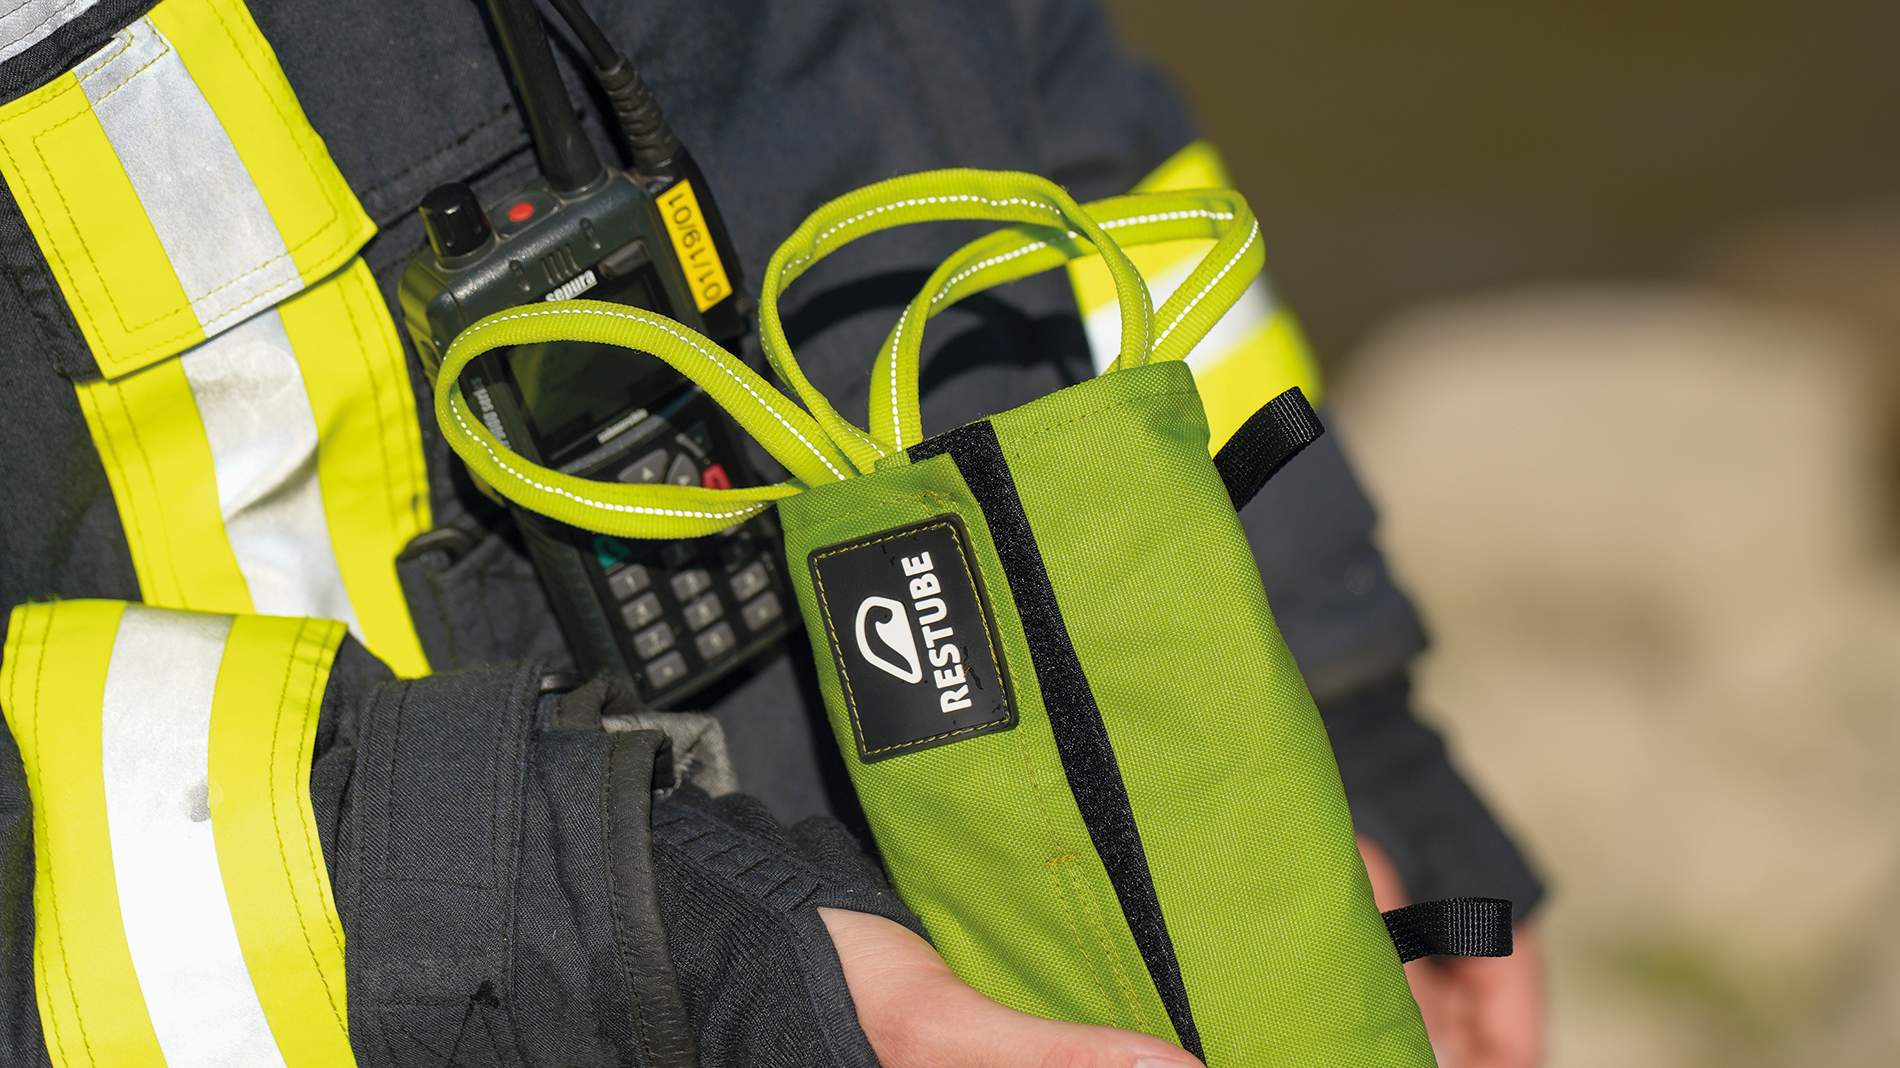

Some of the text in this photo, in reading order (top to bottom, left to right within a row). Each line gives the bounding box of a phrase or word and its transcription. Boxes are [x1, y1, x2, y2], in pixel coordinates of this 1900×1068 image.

[545, 269, 598, 302] sepura
[667, 193, 722, 302] 01/19/01
[901, 551, 973, 713] RESTUBE
